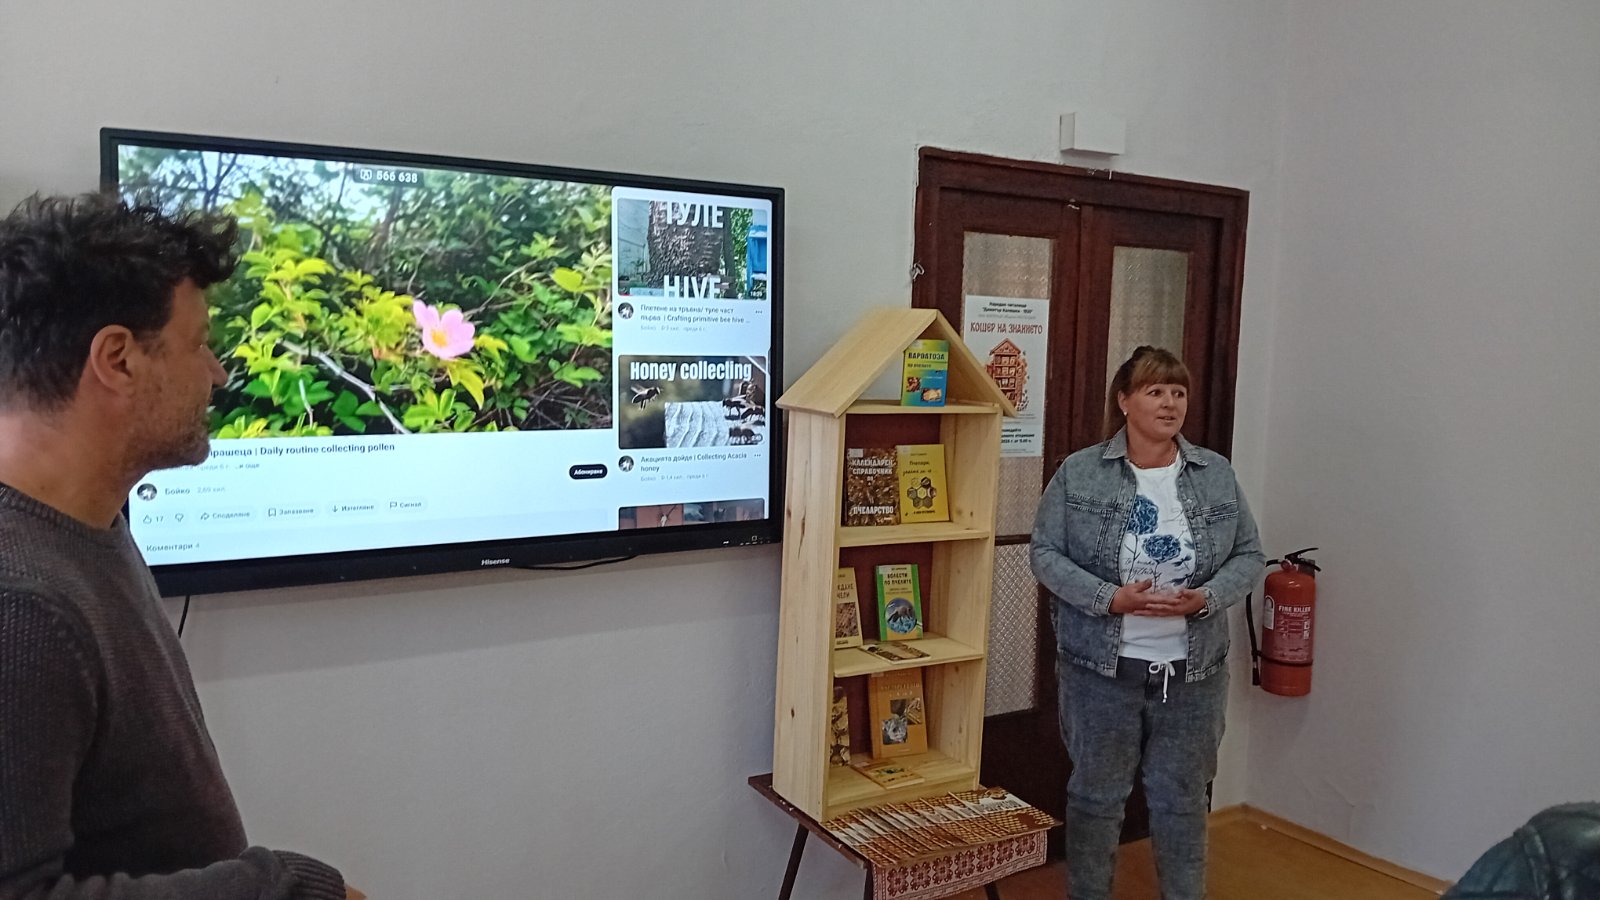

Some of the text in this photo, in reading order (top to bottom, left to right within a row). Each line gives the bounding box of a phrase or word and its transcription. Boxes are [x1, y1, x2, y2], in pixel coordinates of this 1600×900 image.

[663, 274, 721, 299] HIVE
[667, 314, 692, 323] Crafting
[692, 315, 719, 323] primitive
[970, 322, 1043, 335] КОШЕР НА ЗНАНИЕТО
[629, 360, 752, 381] Honey collecting
[260, 446, 283, 456] Daily
[286, 445, 319, 455] routine
[321, 444, 366, 454] collecting
[367, 443, 396, 453] pollen
[697, 453, 726, 461] Collecting
[852, 458, 893, 466] КАЛЕНДАРЕН
[640, 465, 660, 473] honey
[852, 467, 893, 475] СПРАВОЧНИК
[853, 506, 894, 515] ПЧЕЛАРСТВО
[146, 543, 193, 552] Коментари
[481, 558, 511, 566] Hisense
